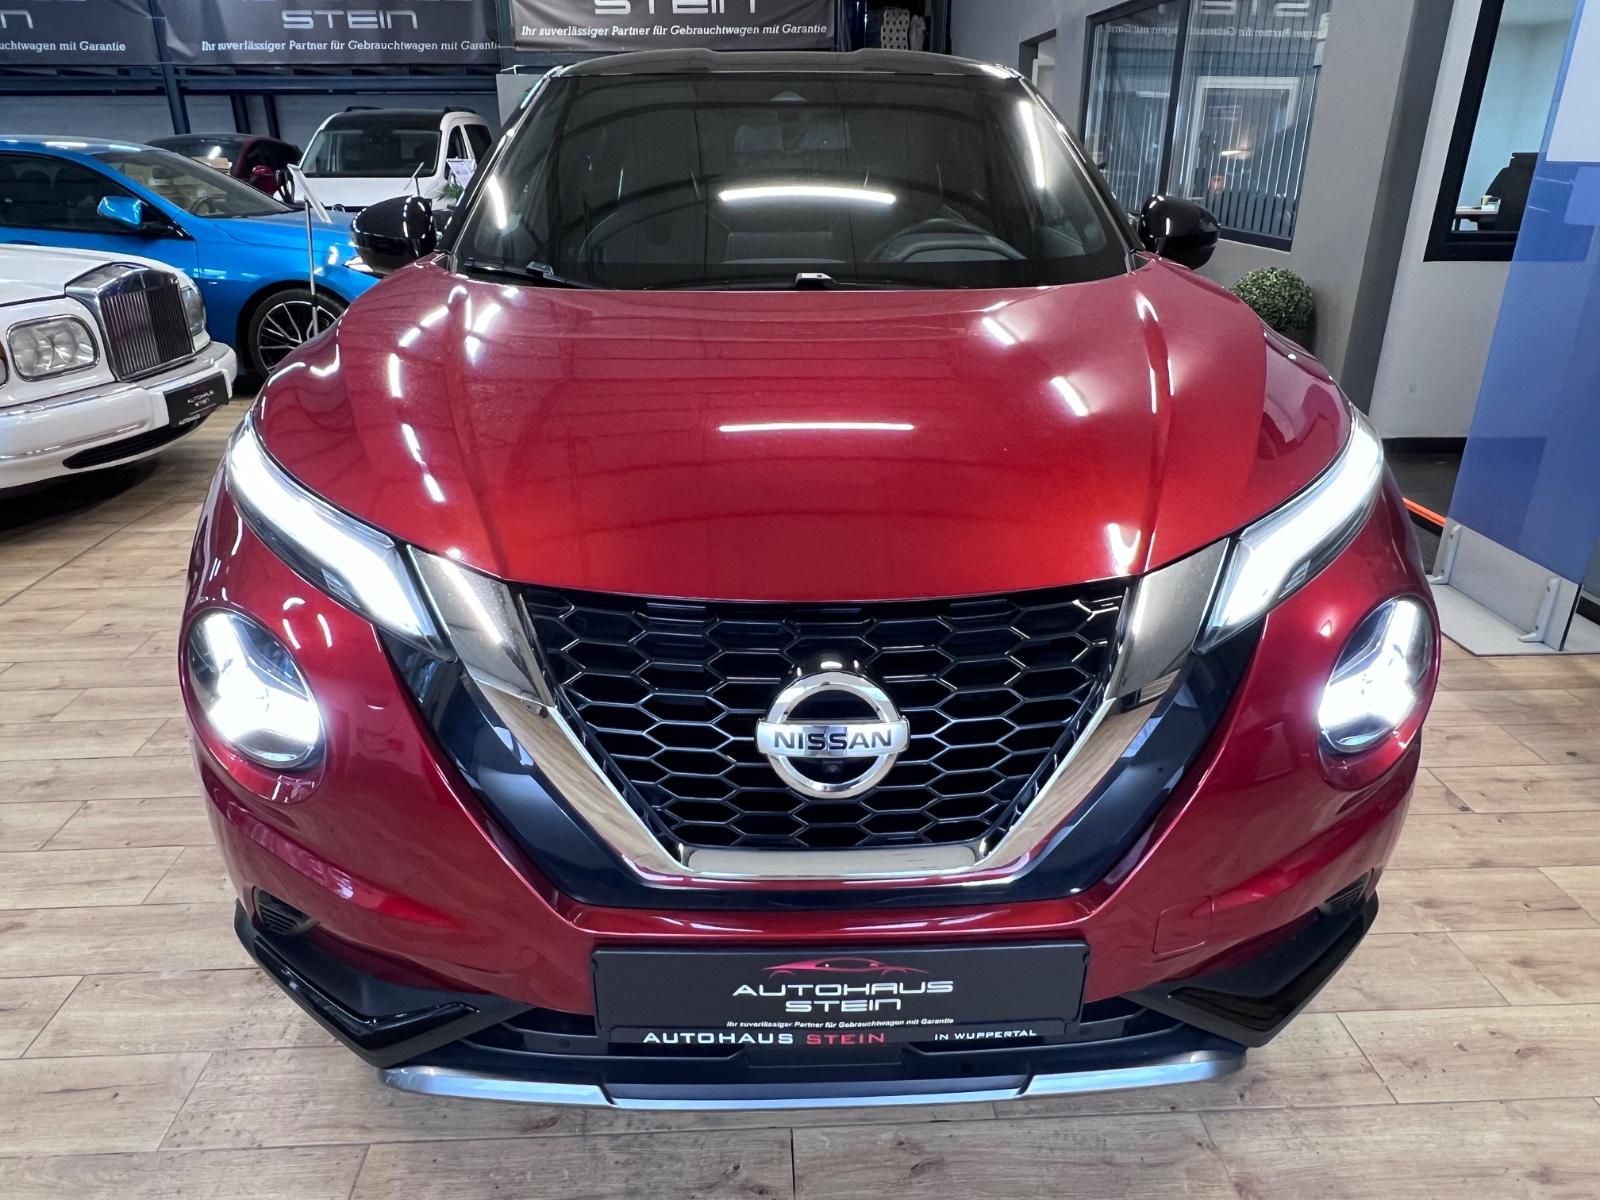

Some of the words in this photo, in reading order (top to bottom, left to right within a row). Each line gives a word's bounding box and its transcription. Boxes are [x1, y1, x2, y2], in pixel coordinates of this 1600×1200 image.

[281, 9, 418, 29] STEIN
[521, 25, 538, 36] Ihr
[538, 26, 609, 39] zuverlässiger
[611, 25, 651, 36] Partner
[652, 25, 668, 36] für
[670, 25, 760, 37] Gebrauchtwagen
[762, 24, 780, 34] mit
[781, 24, 828, 34] Garantie
[59, 41, 77, 51] mit
[79, 40, 127, 52] Garantie
[201, 41, 216, 51] Ihr
[217, 40, 287, 53] zuverlässiger
[289, 40, 328, 51] Partner
[330, 40, 345, 51] für
[347, 40, 438, 53] Gebrauchtwagen
[440, 40, 458, 51] mit
[460, 40, 498, 51] Garanti
[774, 730, 892, 751] NISSAN
[732, 981, 954, 997] AUTOHAUS
[785, 998, 902, 1013] STEIN
[794, 1021, 823, 1029] Partner
[825, 1021, 837, 1029] für
[838, 1019, 905, 1029] Gebrauchtwagen
[906, 1018, 920, 1026] mit
[920, 1017, 955, 1025] Garantie
[642, 1032, 794, 1045] AUTOHAUS
[806, 1032, 885, 1046] STEIN
[934, 1033, 949, 1041] IN
[954, 1029, 1037, 1040] WUPPERTAL
